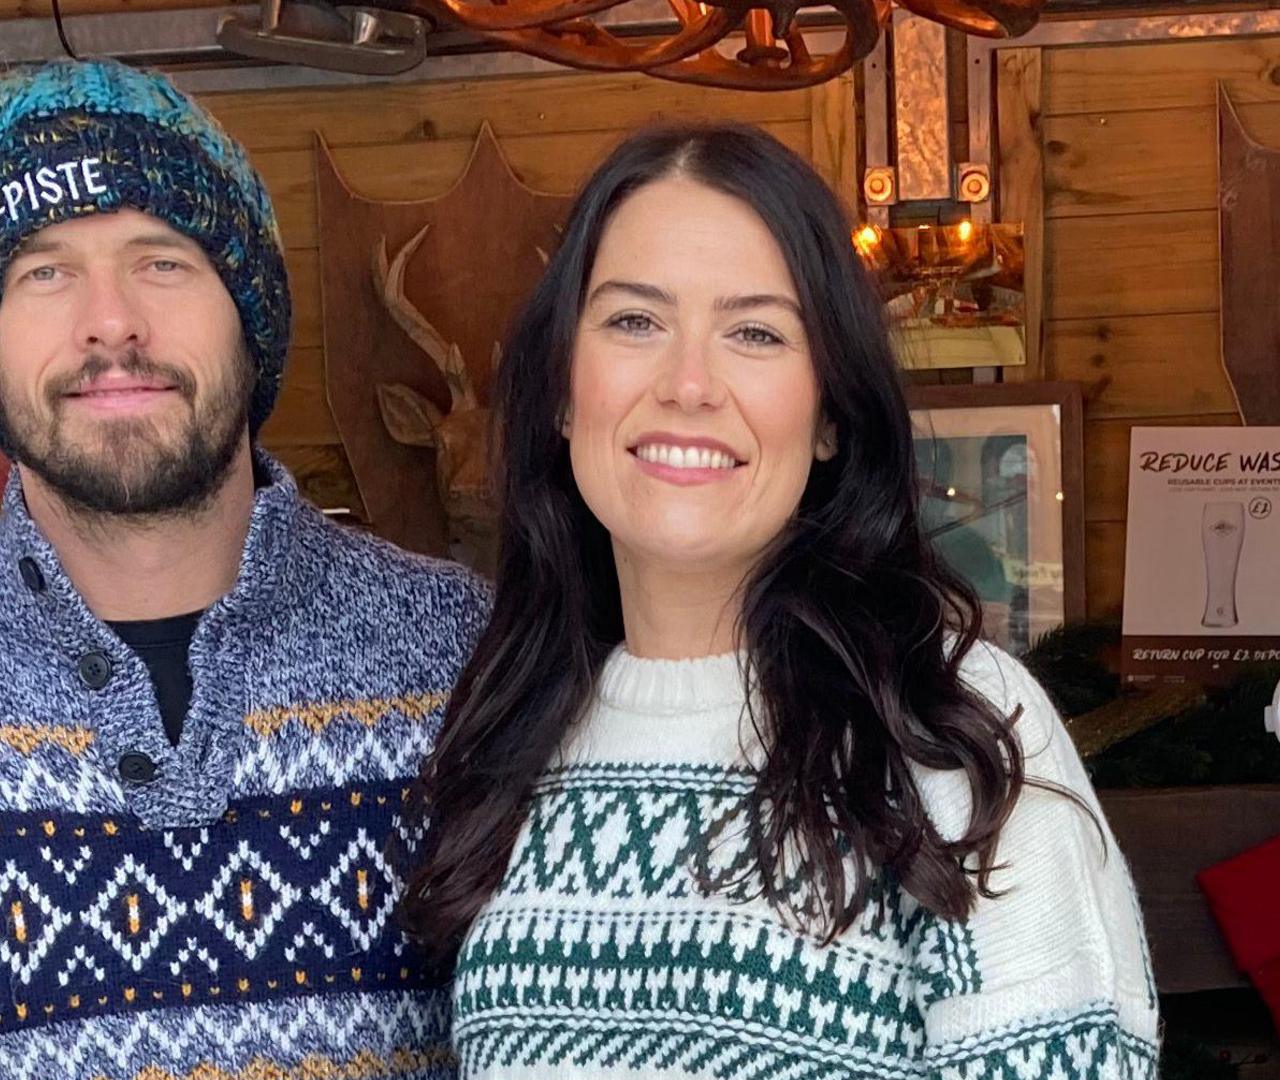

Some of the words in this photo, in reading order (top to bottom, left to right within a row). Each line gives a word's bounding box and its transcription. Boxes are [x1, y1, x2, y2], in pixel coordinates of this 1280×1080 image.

[1139, 451, 1232, 473] REDUCE
[1237, 478, 1248, 486] AT
[1132, 648, 1180, 661] RETURN
[1181, 648, 1206, 661] CUP
[1207, 649, 1230, 661] FOR
